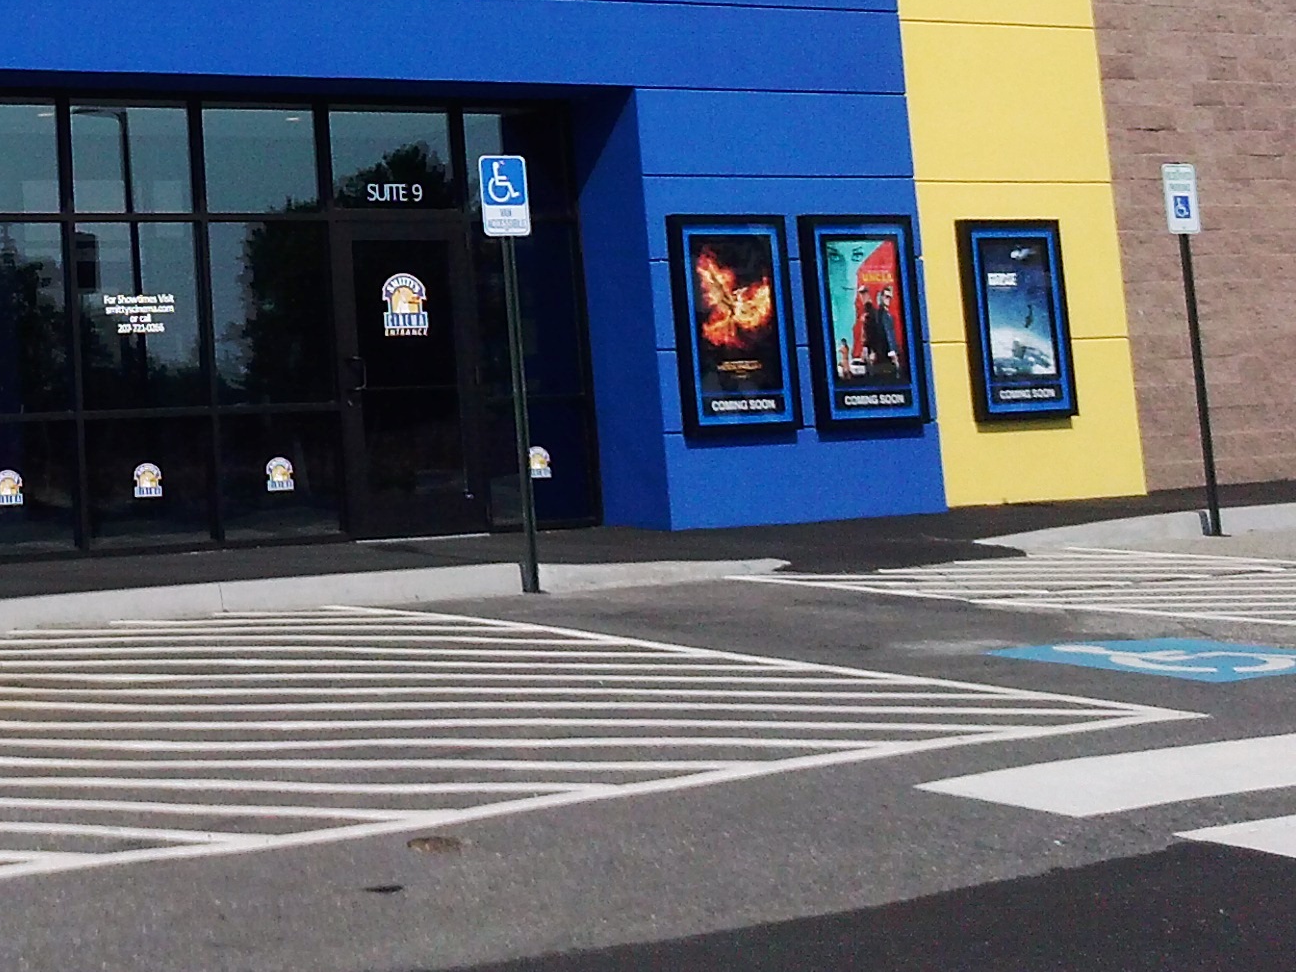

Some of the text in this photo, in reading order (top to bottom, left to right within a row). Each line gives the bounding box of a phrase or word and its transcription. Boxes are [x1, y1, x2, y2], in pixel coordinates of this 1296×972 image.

[366, 182, 423, 202] SUITE 9
[104, 293, 175, 304] For Showtimes Visit
[129, 313, 152, 323] or call
[711, 398, 776, 412] COMING SOON
[844, 393, 905, 406] COMING SOON
